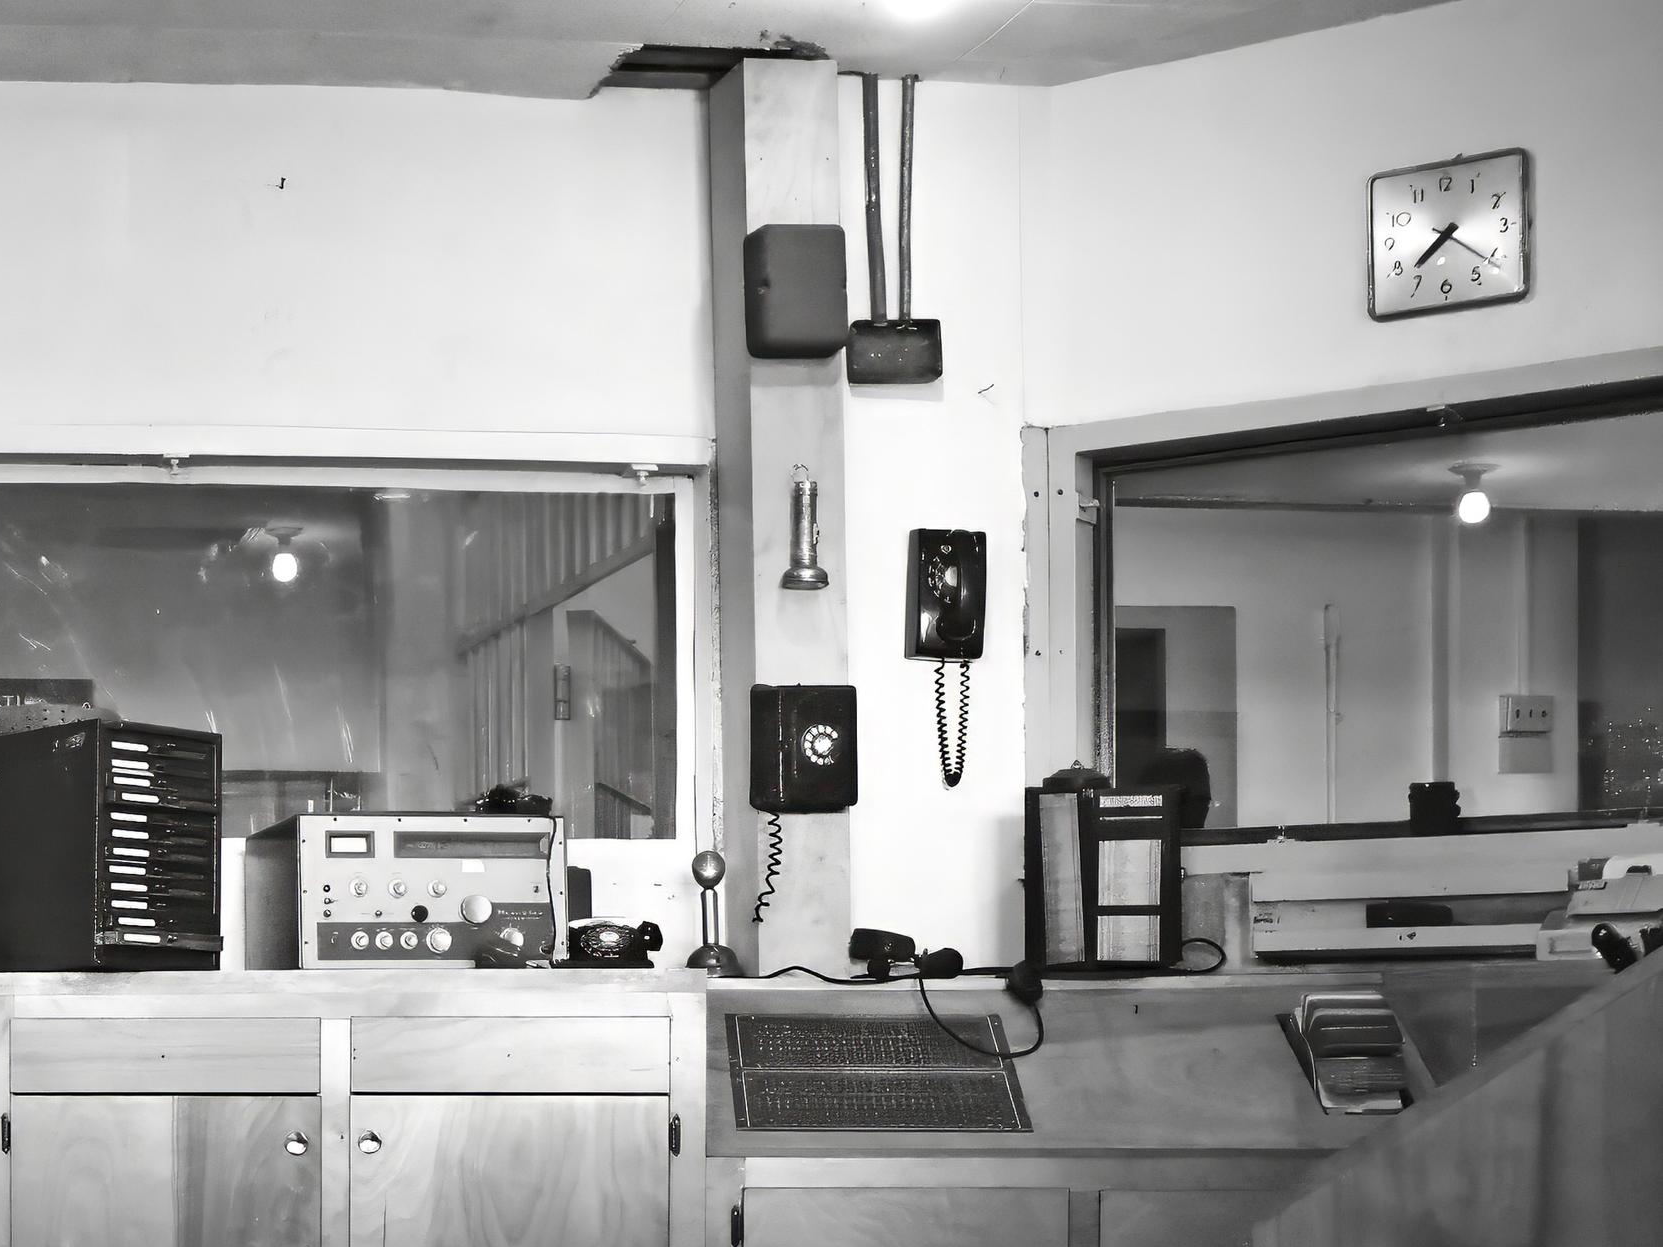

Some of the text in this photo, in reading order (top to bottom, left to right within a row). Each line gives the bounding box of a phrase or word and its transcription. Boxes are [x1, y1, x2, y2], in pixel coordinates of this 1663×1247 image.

[1439, 177, 1453, 192] 12
[1413, 188, 1424, 204] 11
[1391, 212, 1412, 227] 10
[1499, 217, 1509, 233] 3
[1384, 237, 1395, 251] 9
[1392, 260, 1404, 276] 8
[1470, 265, 1481, 282] 5
[1410, 275, 1423, 298] 7
[1440, 279, 1453, 294] 6
